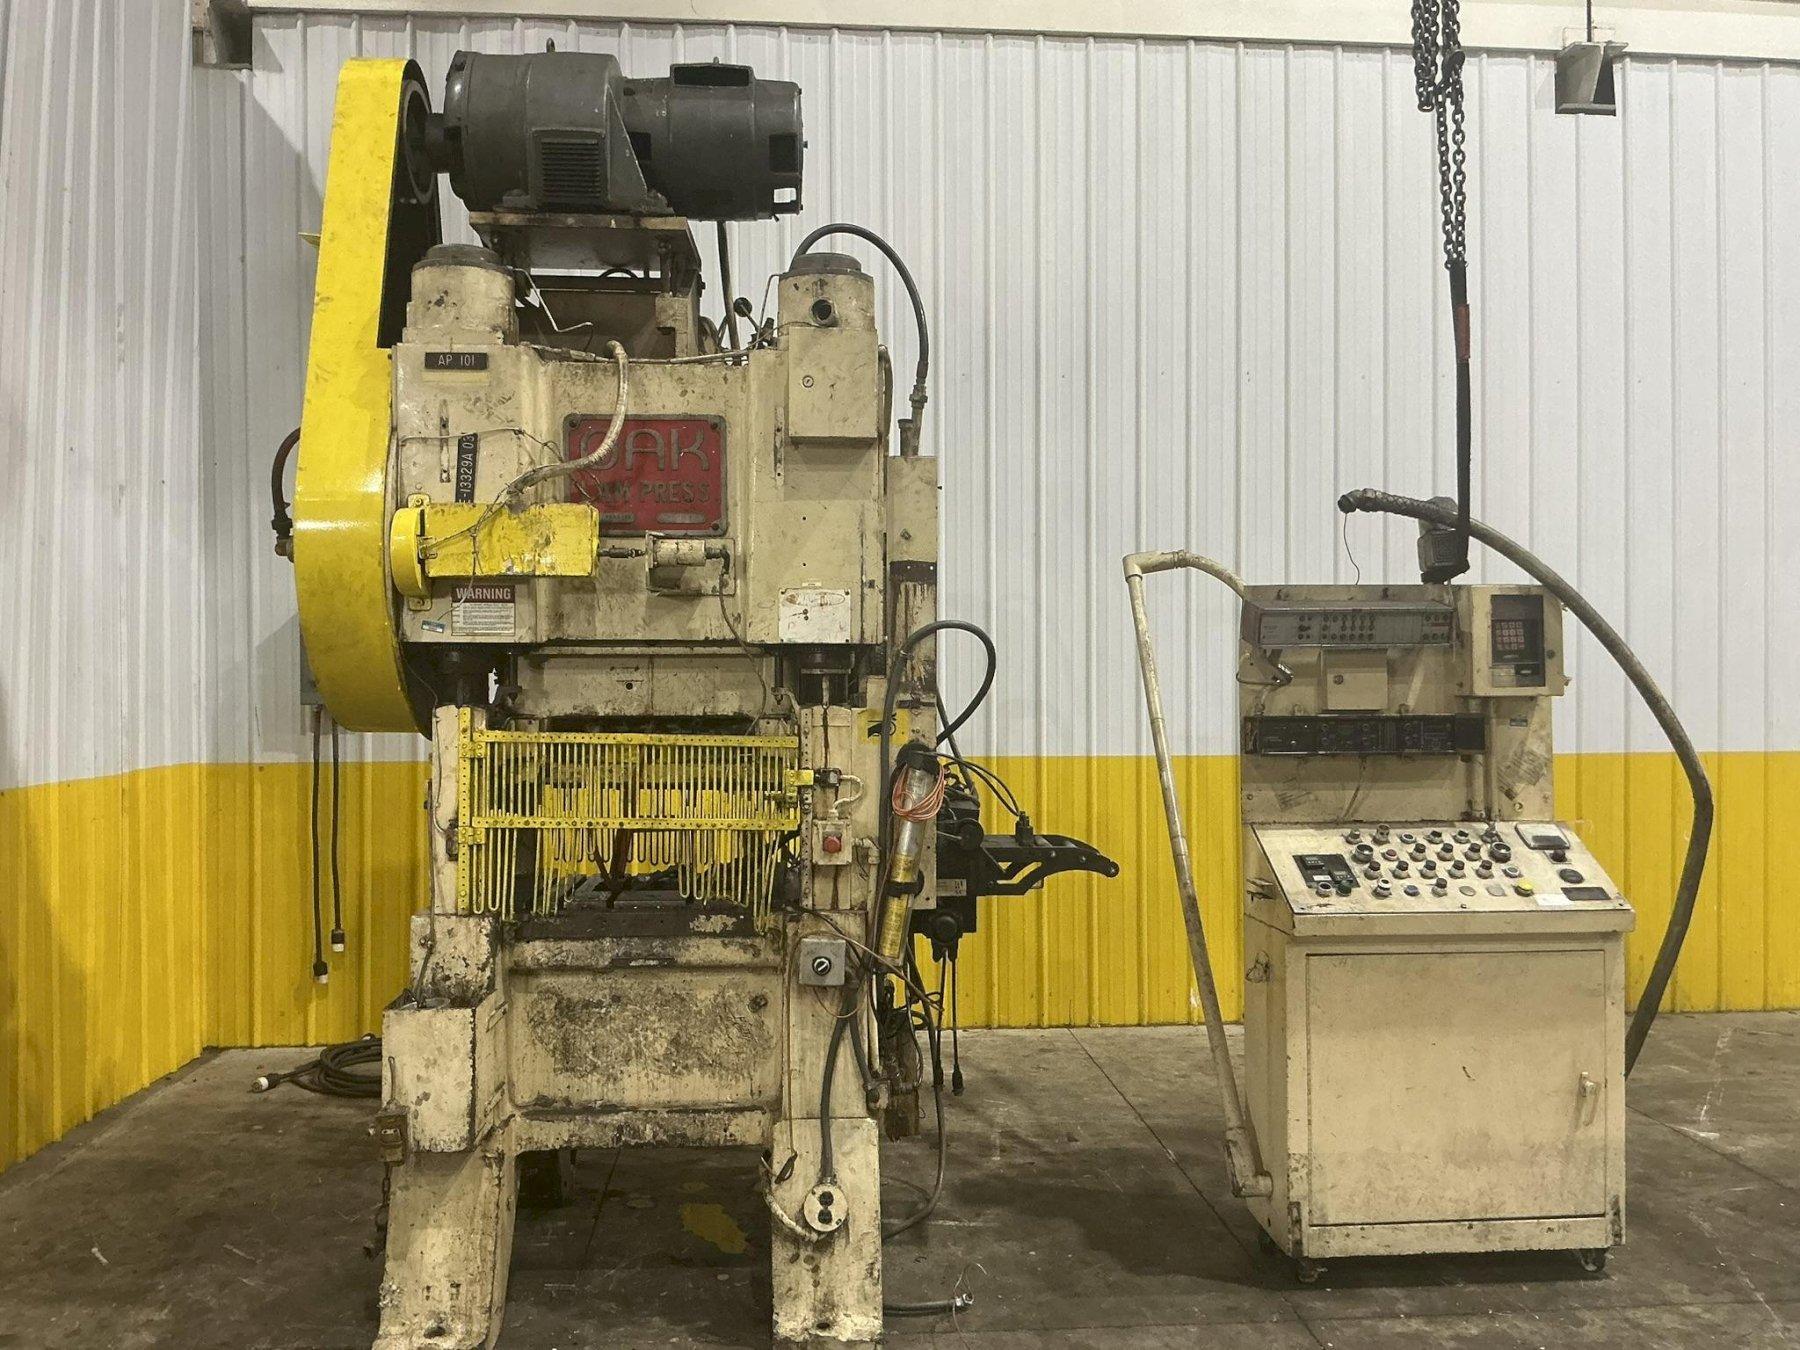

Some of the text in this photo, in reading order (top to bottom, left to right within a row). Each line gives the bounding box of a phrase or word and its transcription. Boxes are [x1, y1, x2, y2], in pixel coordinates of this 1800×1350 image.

[438, 354, 475, 367] AP 101
[580, 428, 709, 472] OAK
[640, 479, 710, 504] PRESS
[456, 587, 511, 600] WARNING
